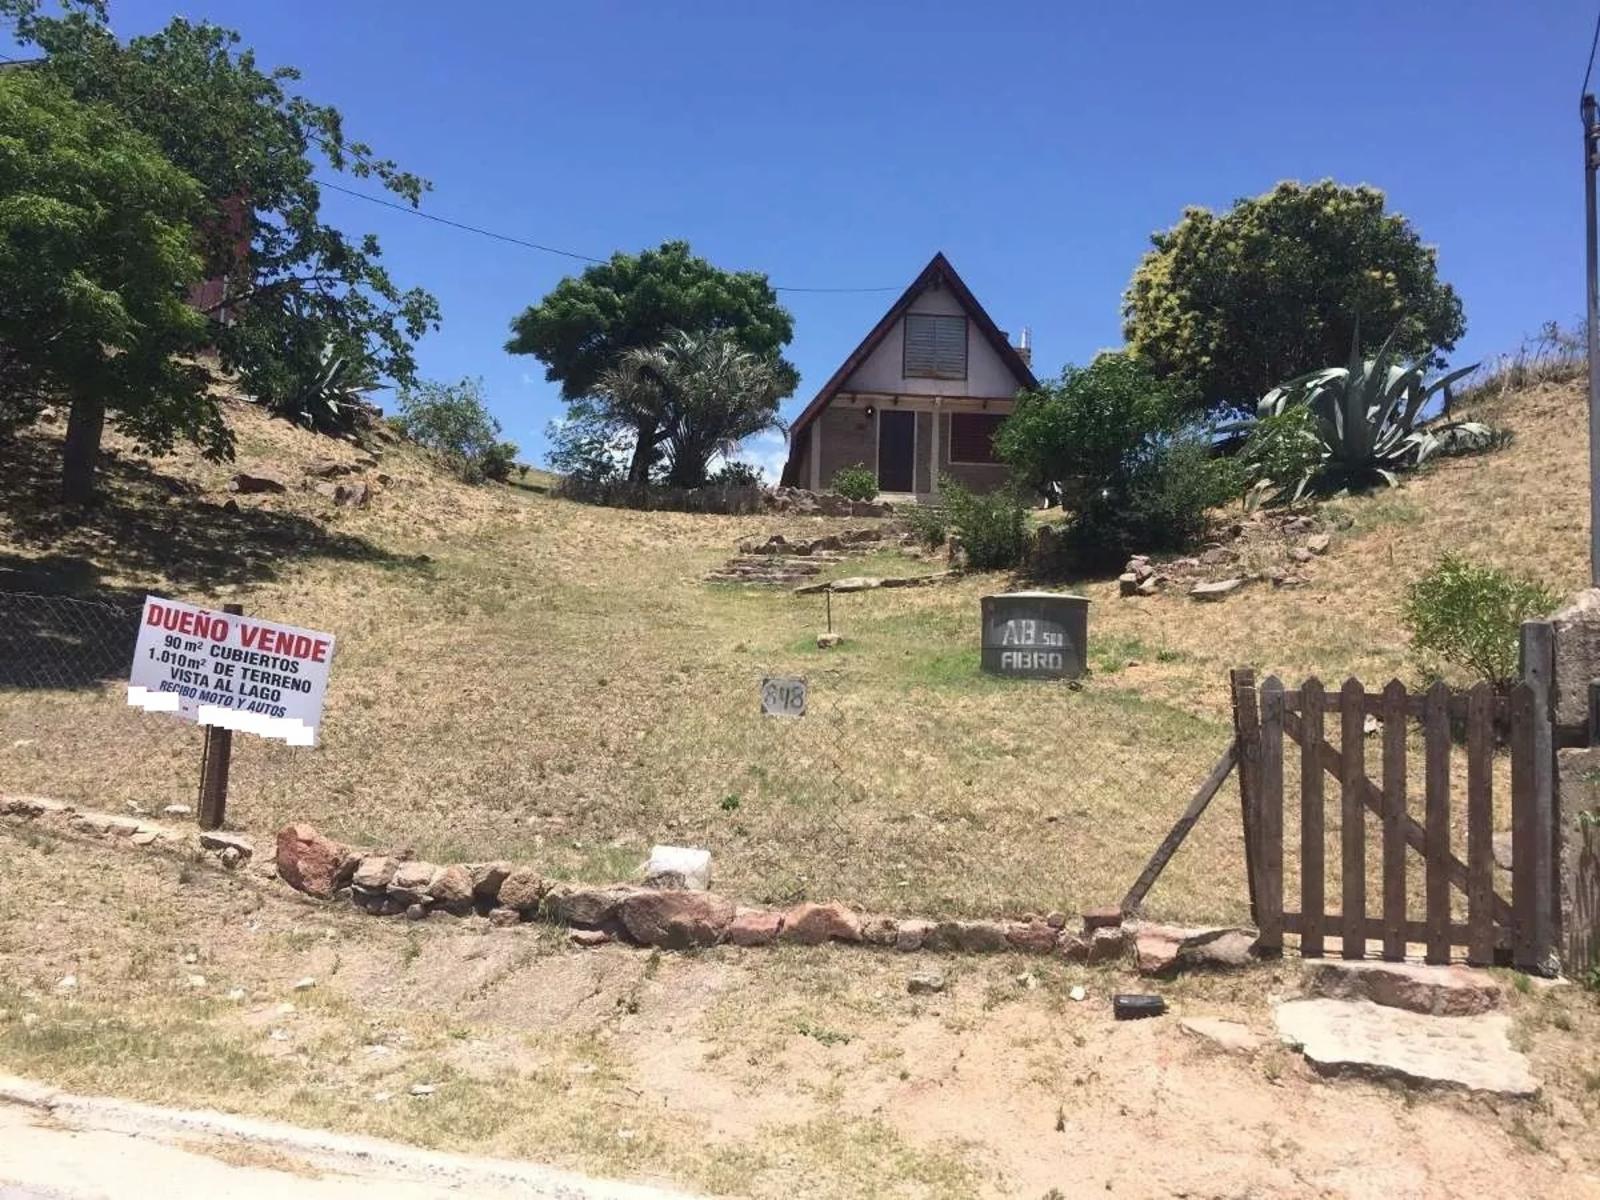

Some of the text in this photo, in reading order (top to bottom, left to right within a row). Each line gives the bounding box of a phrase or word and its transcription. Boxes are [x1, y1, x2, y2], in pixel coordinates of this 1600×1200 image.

[147, 603, 328, 663] DUEÑO VENDE
[164, 635, 181, 649] 90
[210, 644, 299, 673] CUBIERTOS
[171, 667, 280, 702] VISTA AL LAGO
[214, 662, 234, 677] DE
[241, 667, 311, 693] TERRENO
[160, 681, 287, 718] RECIBO MOTO Y AUTOS
